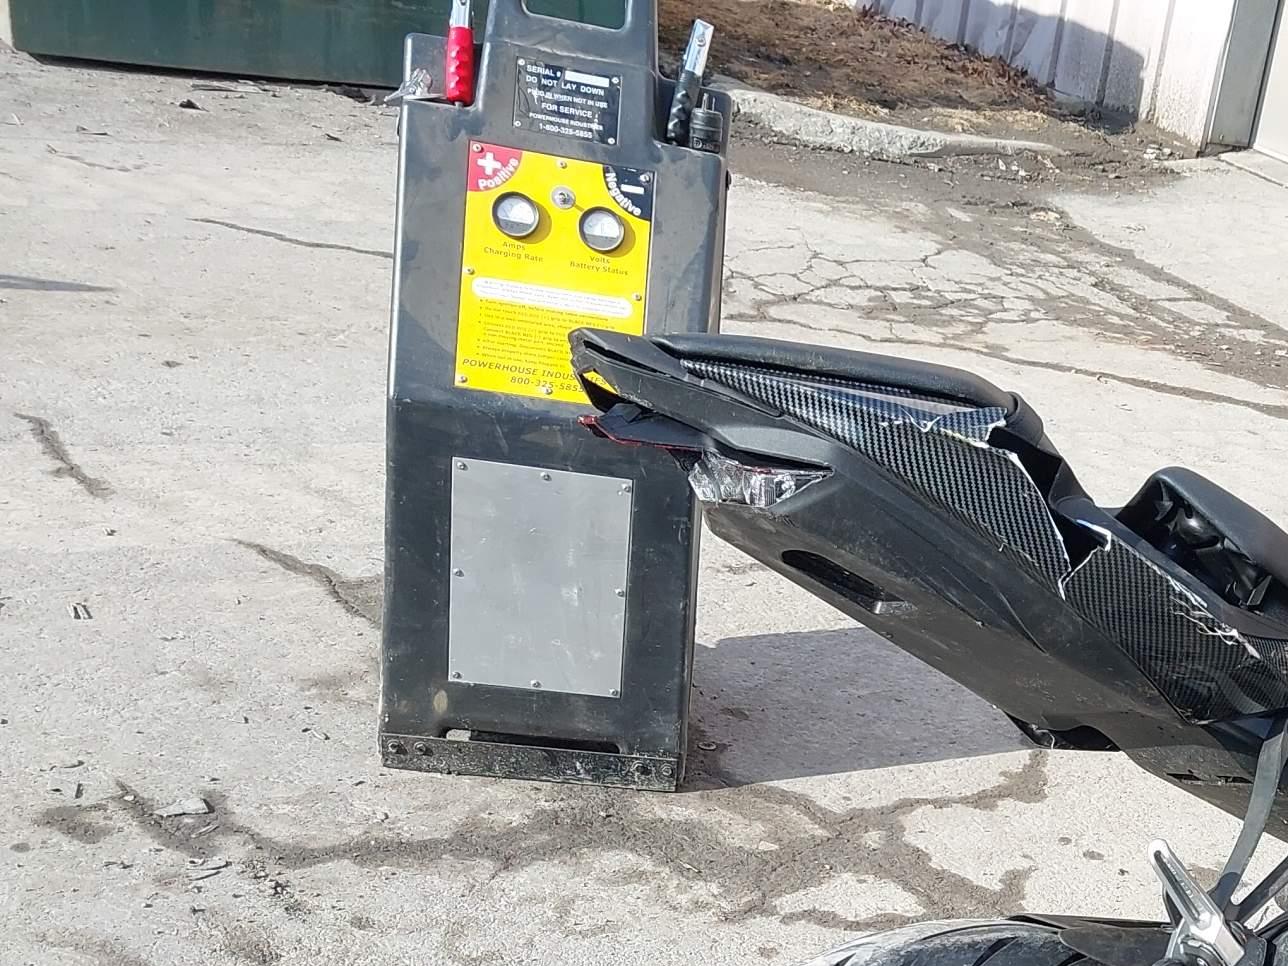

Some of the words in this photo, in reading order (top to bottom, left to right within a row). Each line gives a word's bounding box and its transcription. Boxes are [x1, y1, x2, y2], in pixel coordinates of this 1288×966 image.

[526, 64, 554, 76] SERIAL
[526, 75, 538, 83] DO
[541, 78, 558, 87] NOT
[562, 82, 576, 90] LAY
[580, 86, 604, 96] DOWN
[554, 93, 572, 102] WHEN
[573, 96, 586, 105] NOT
[587, 98, 594, 106] IN
[595, 100, 608, 108] USE
[542, 102, 558, 111] FOR
[560, 106, 592, 118] SERVICE
[529, 112, 570, 124] POWERHOUSE
[539, 123, 593, 138] 1-800-325-5855
[478, 157, 520, 190] Positive
[605, 171, 642, 216] Negative
[484, 246, 522, 260] Charging
[524, 254, 544, 262] Rate
[502, 241, 526, 252] Amps
[590, 256, 611, 264] Volts
[570, 261, 600, 272] Battery
[602, 265, 629, 276] Status
[462, 358, 538, 376] POWERHOUSE
